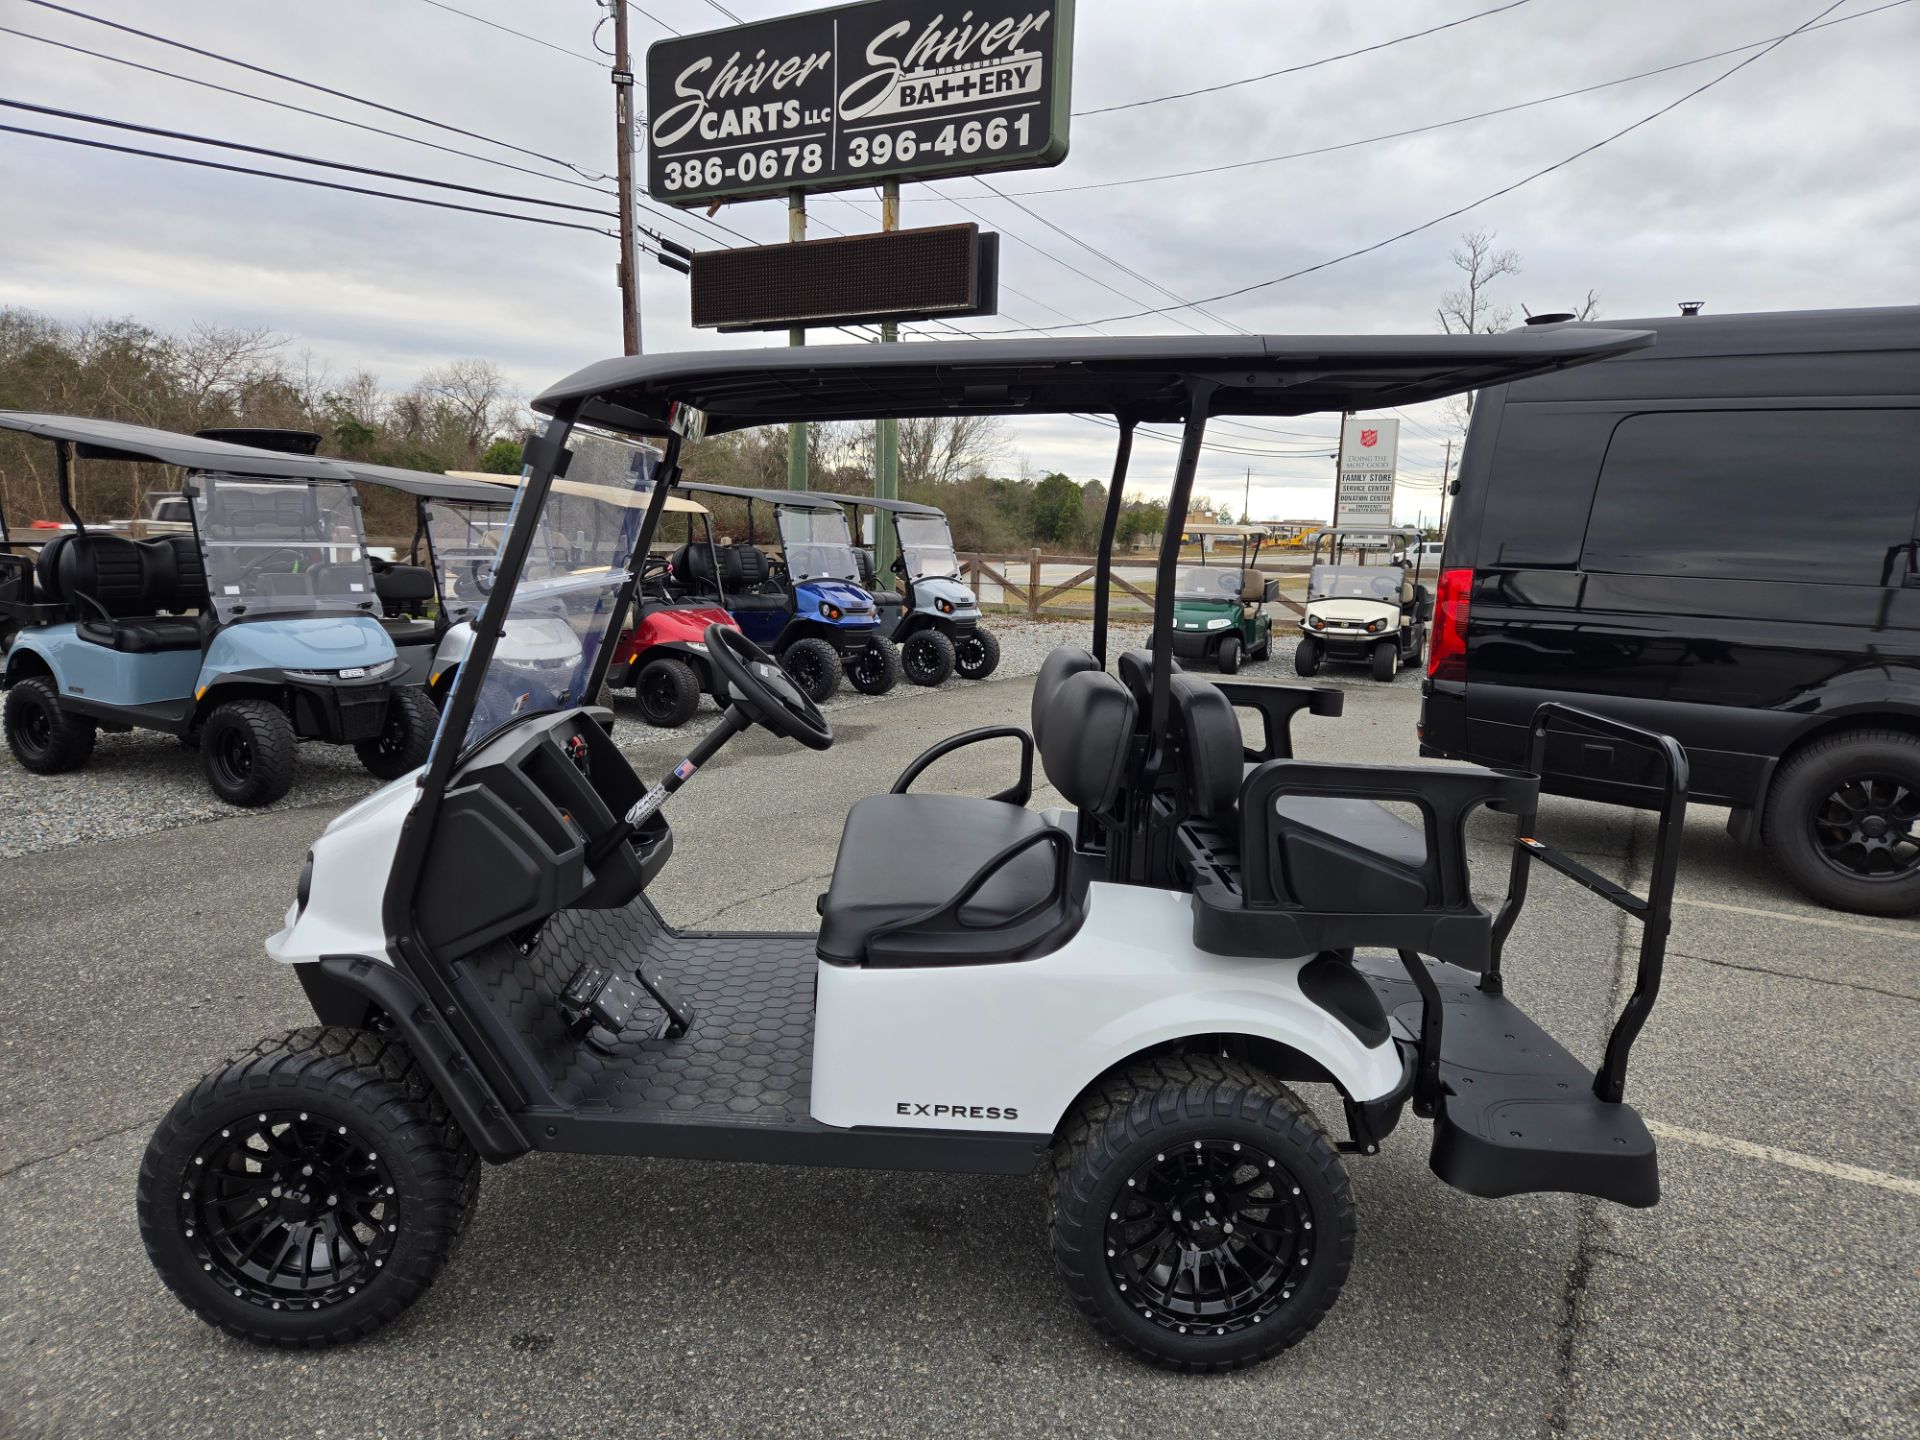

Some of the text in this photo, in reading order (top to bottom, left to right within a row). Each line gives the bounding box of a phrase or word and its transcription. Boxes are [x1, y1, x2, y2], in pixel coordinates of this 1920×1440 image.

[839, 10, 1050, 121] Shiver
[652, 48, 832, 148] Shiver
[699, 99, 831, 140] CARTS LLC
[848, 113, 1031, 168] 396-4661
[663, 143, 823, 191] 386-0678
[1342, 474, 1392, 482] FAMILY STORE
[896, 1102, 1018, 1120] EXPRESS
